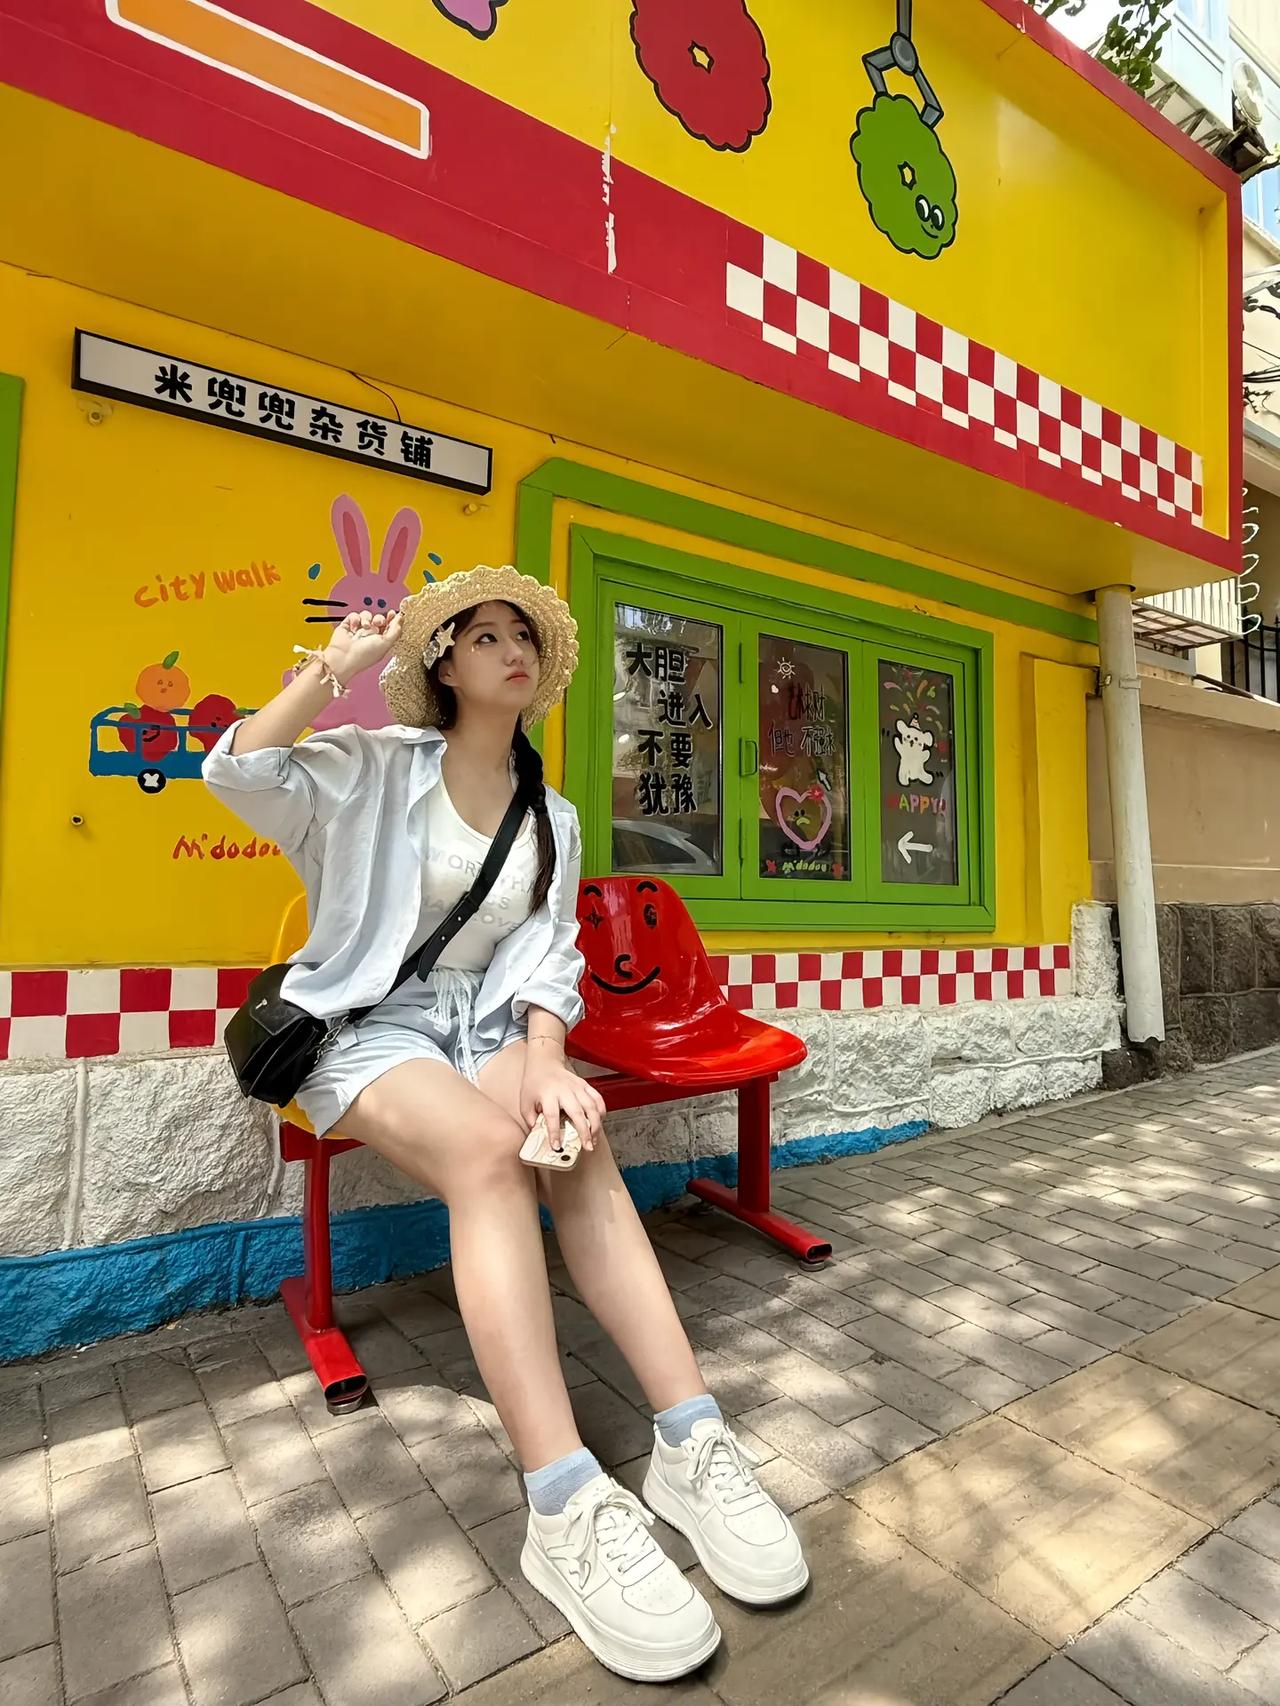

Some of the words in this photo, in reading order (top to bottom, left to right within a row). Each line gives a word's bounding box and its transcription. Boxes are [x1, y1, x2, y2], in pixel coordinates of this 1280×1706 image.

[154, 363, 432, 470] 米兜兜杂货铺
[213, 560, 281, 594] walk
[625, 641, 686, 685] 大胆
[657, 690, 714, 730] 进入
[637, 729, 694, 770] 不要
[637, 772, 698, 817] 犹豫
